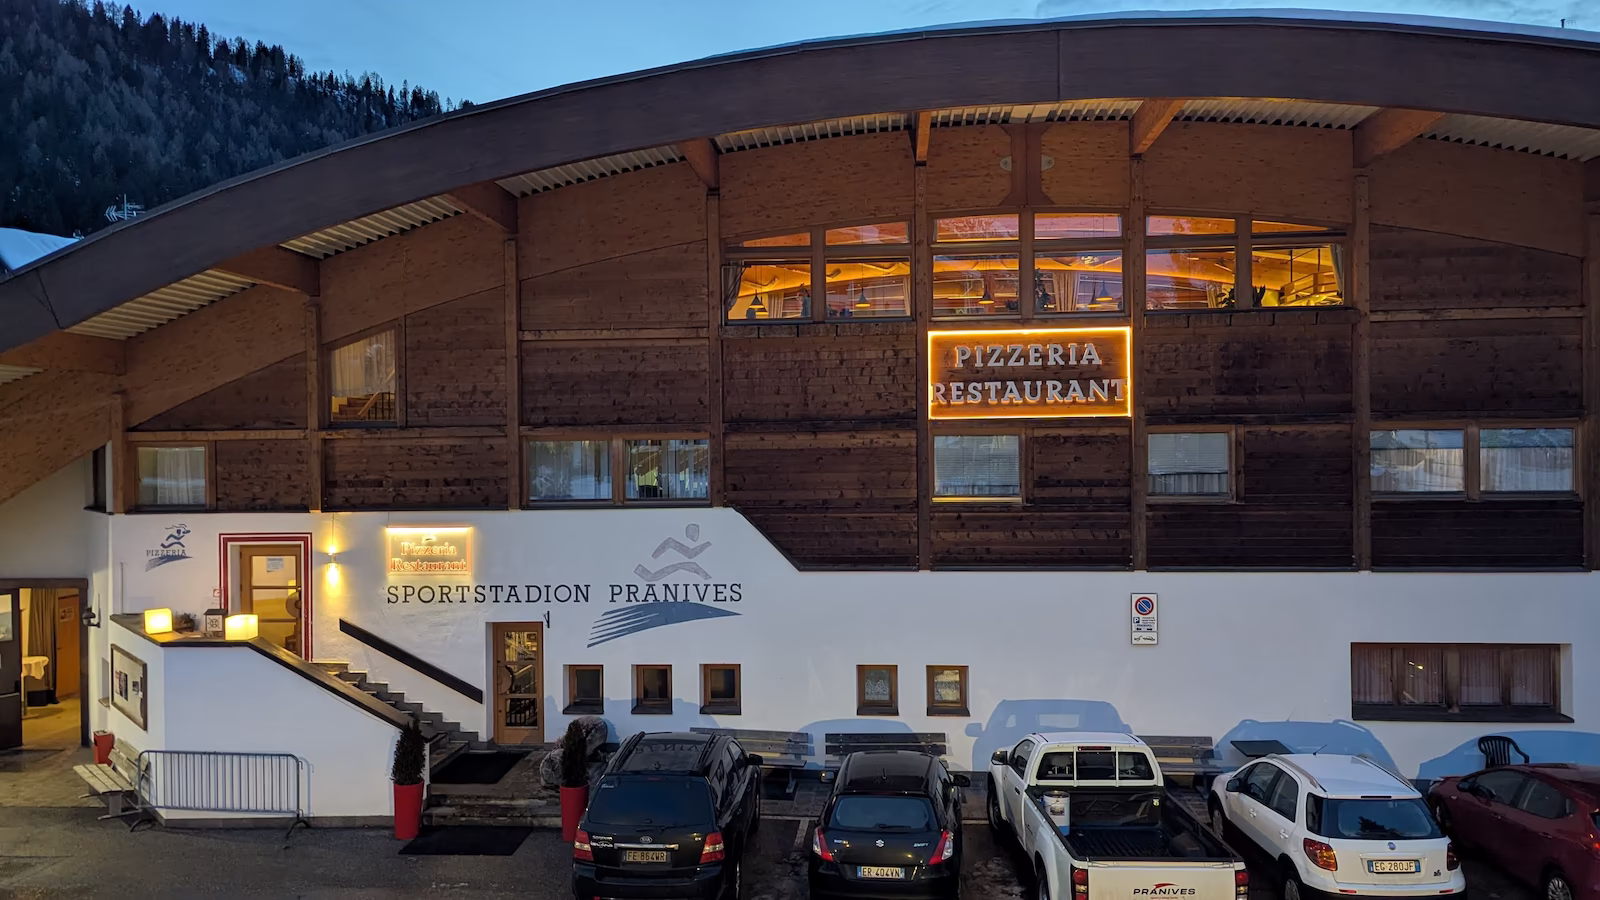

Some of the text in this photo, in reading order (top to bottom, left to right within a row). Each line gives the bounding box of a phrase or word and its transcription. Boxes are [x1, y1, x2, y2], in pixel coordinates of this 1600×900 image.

[954, 343, 1103, 368] PIZZERIA
[931, 379, 1128, 405] RESTAURANT
[146, 549, 187, 557] PIZZERIA
[400, 542, 457, 556] Pizzeria
[391, 558, 467, 571] Restaurant
[387, 583, 743, 604] SPORTSTADION PRANIVES
[627, 851, 665, 861] FE 864WR
[862, 868, 900, 877] ER 404VN
